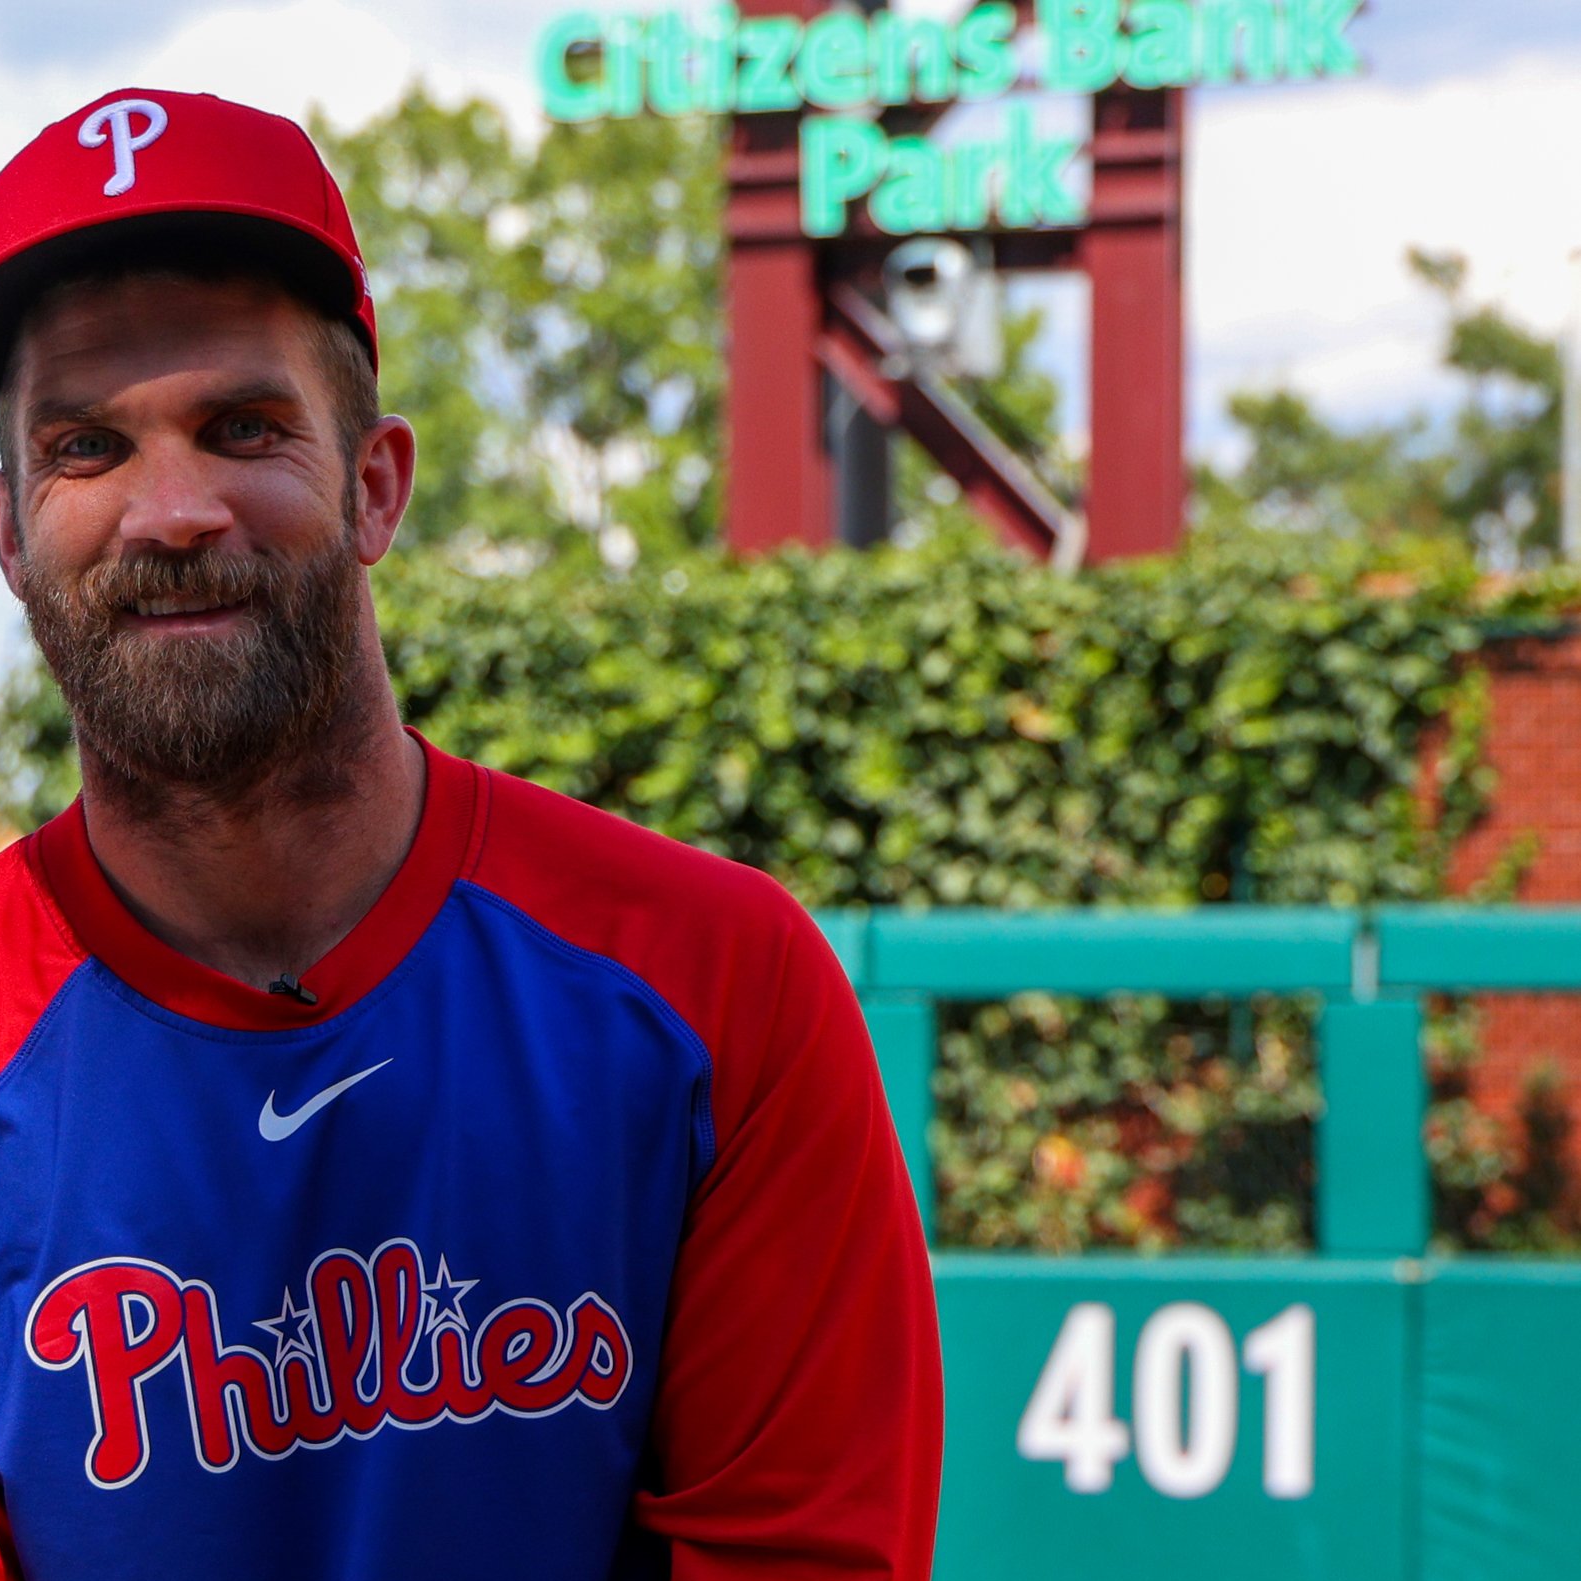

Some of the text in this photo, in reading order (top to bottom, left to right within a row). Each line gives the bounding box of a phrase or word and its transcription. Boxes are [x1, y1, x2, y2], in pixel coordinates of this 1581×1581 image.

[533, 0, 1361, 122] Citizens Bank
[78, 99, 168, 196] P
[799, 95, 1088, 238] Park
[25, 1237, 633, 1490] Phillies
[1017, 1300, 1317, 1500] 401
